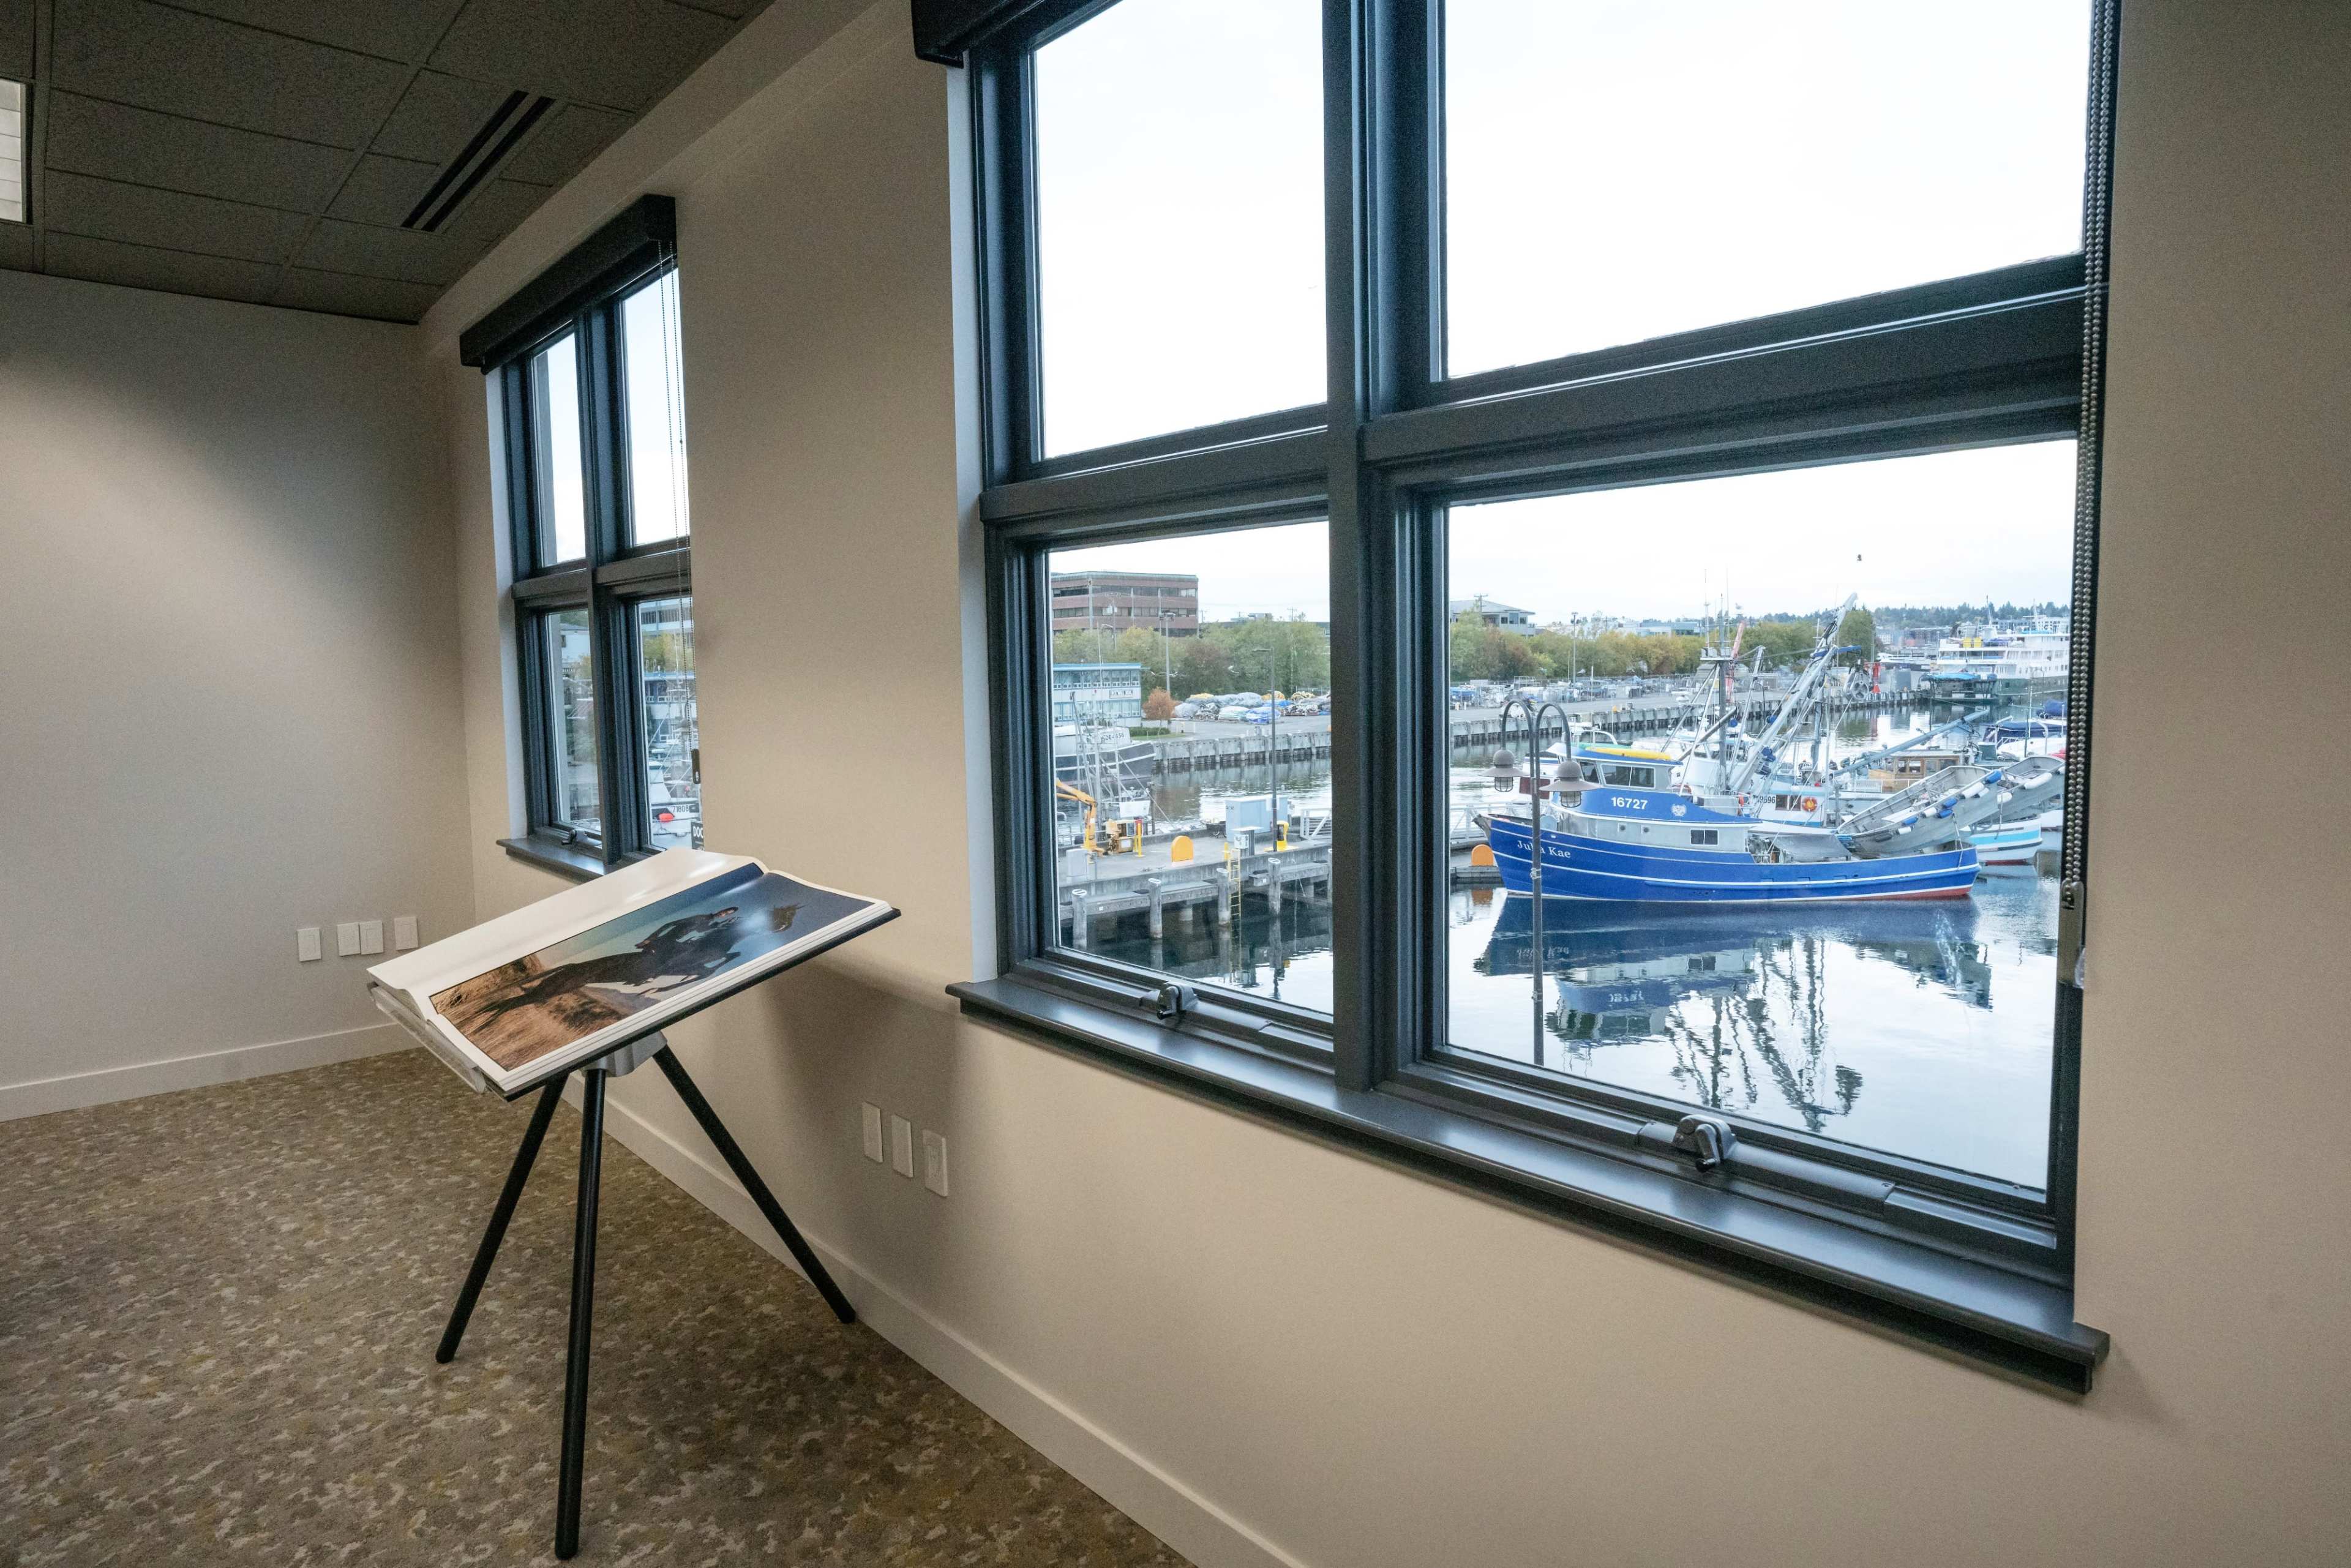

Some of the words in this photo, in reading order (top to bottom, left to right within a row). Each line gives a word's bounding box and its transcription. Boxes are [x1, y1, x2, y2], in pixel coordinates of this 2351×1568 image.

[1611, 797, 1648, 809] 16727
[1517, 840, 1546, 854] Jula
[1548, 846, 1571, 858] Kae
